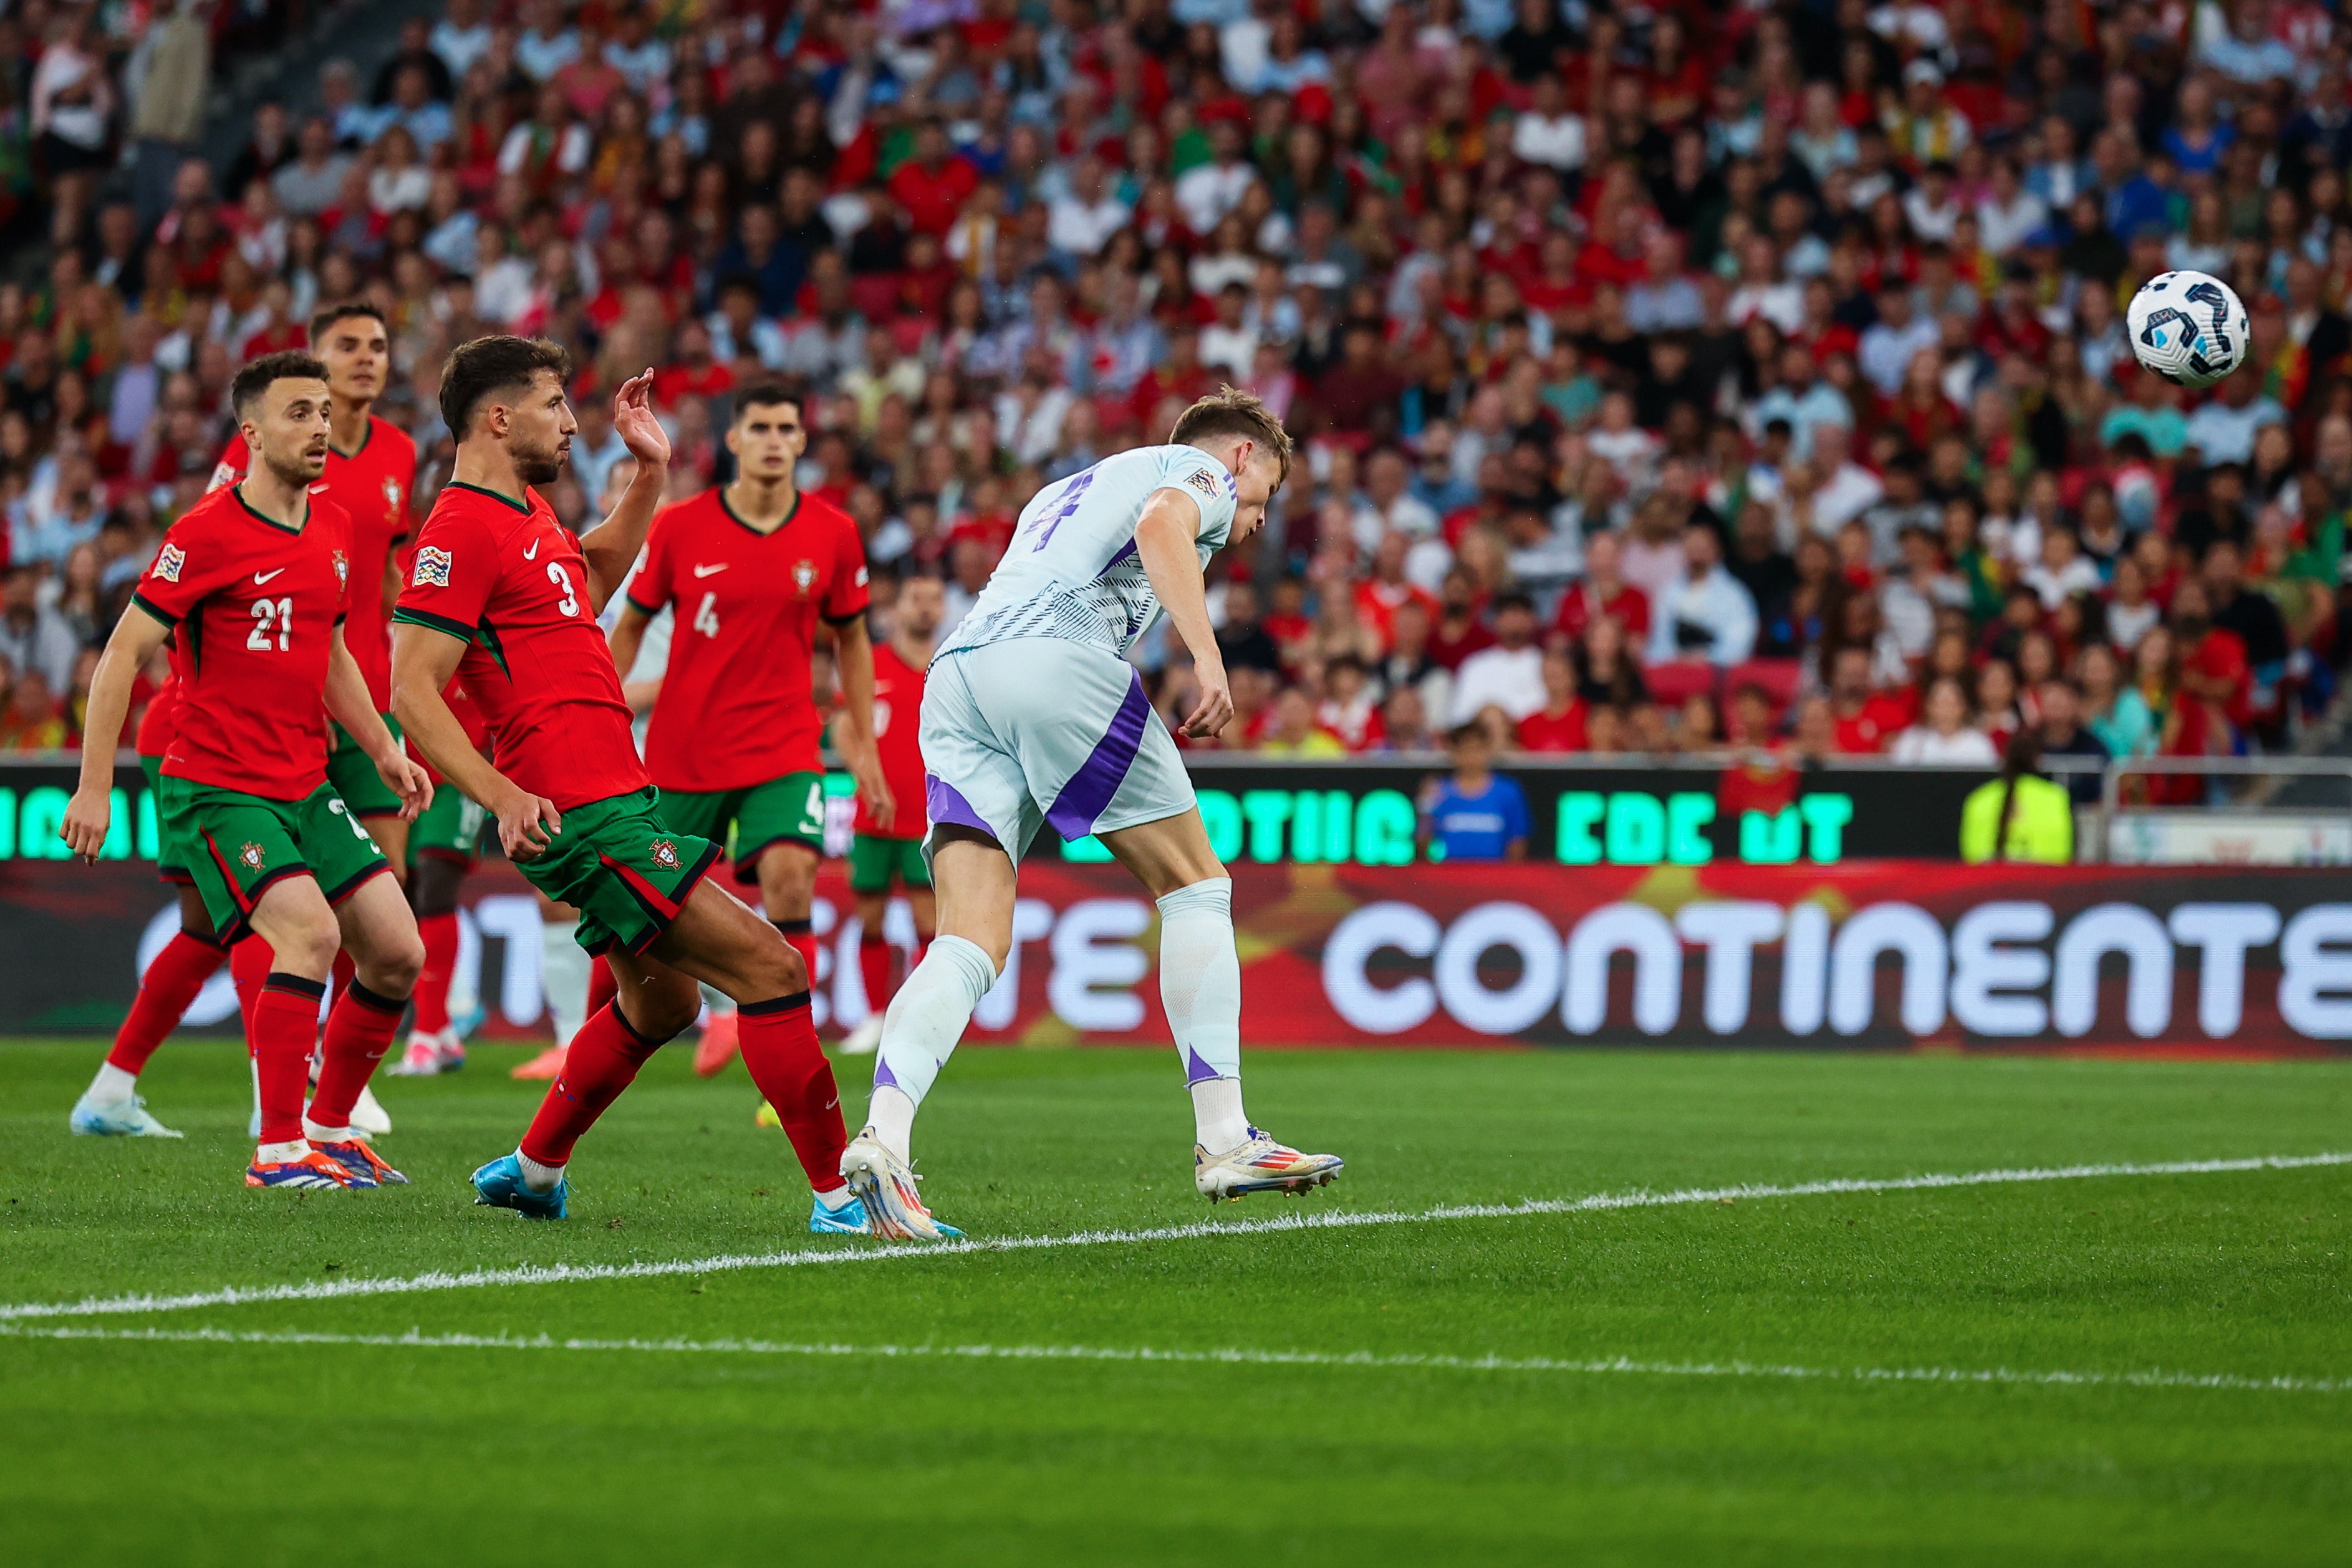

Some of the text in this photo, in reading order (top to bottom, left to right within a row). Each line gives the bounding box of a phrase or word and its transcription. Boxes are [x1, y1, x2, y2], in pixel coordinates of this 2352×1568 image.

[547, 561, 580, 617] 3
[693, 591, 720, 639] 4
[247, 597, 292, 652] 21
[805, 782, 824, 825] 4
[1323, 900, 2352, 1039] CONTINENTE
